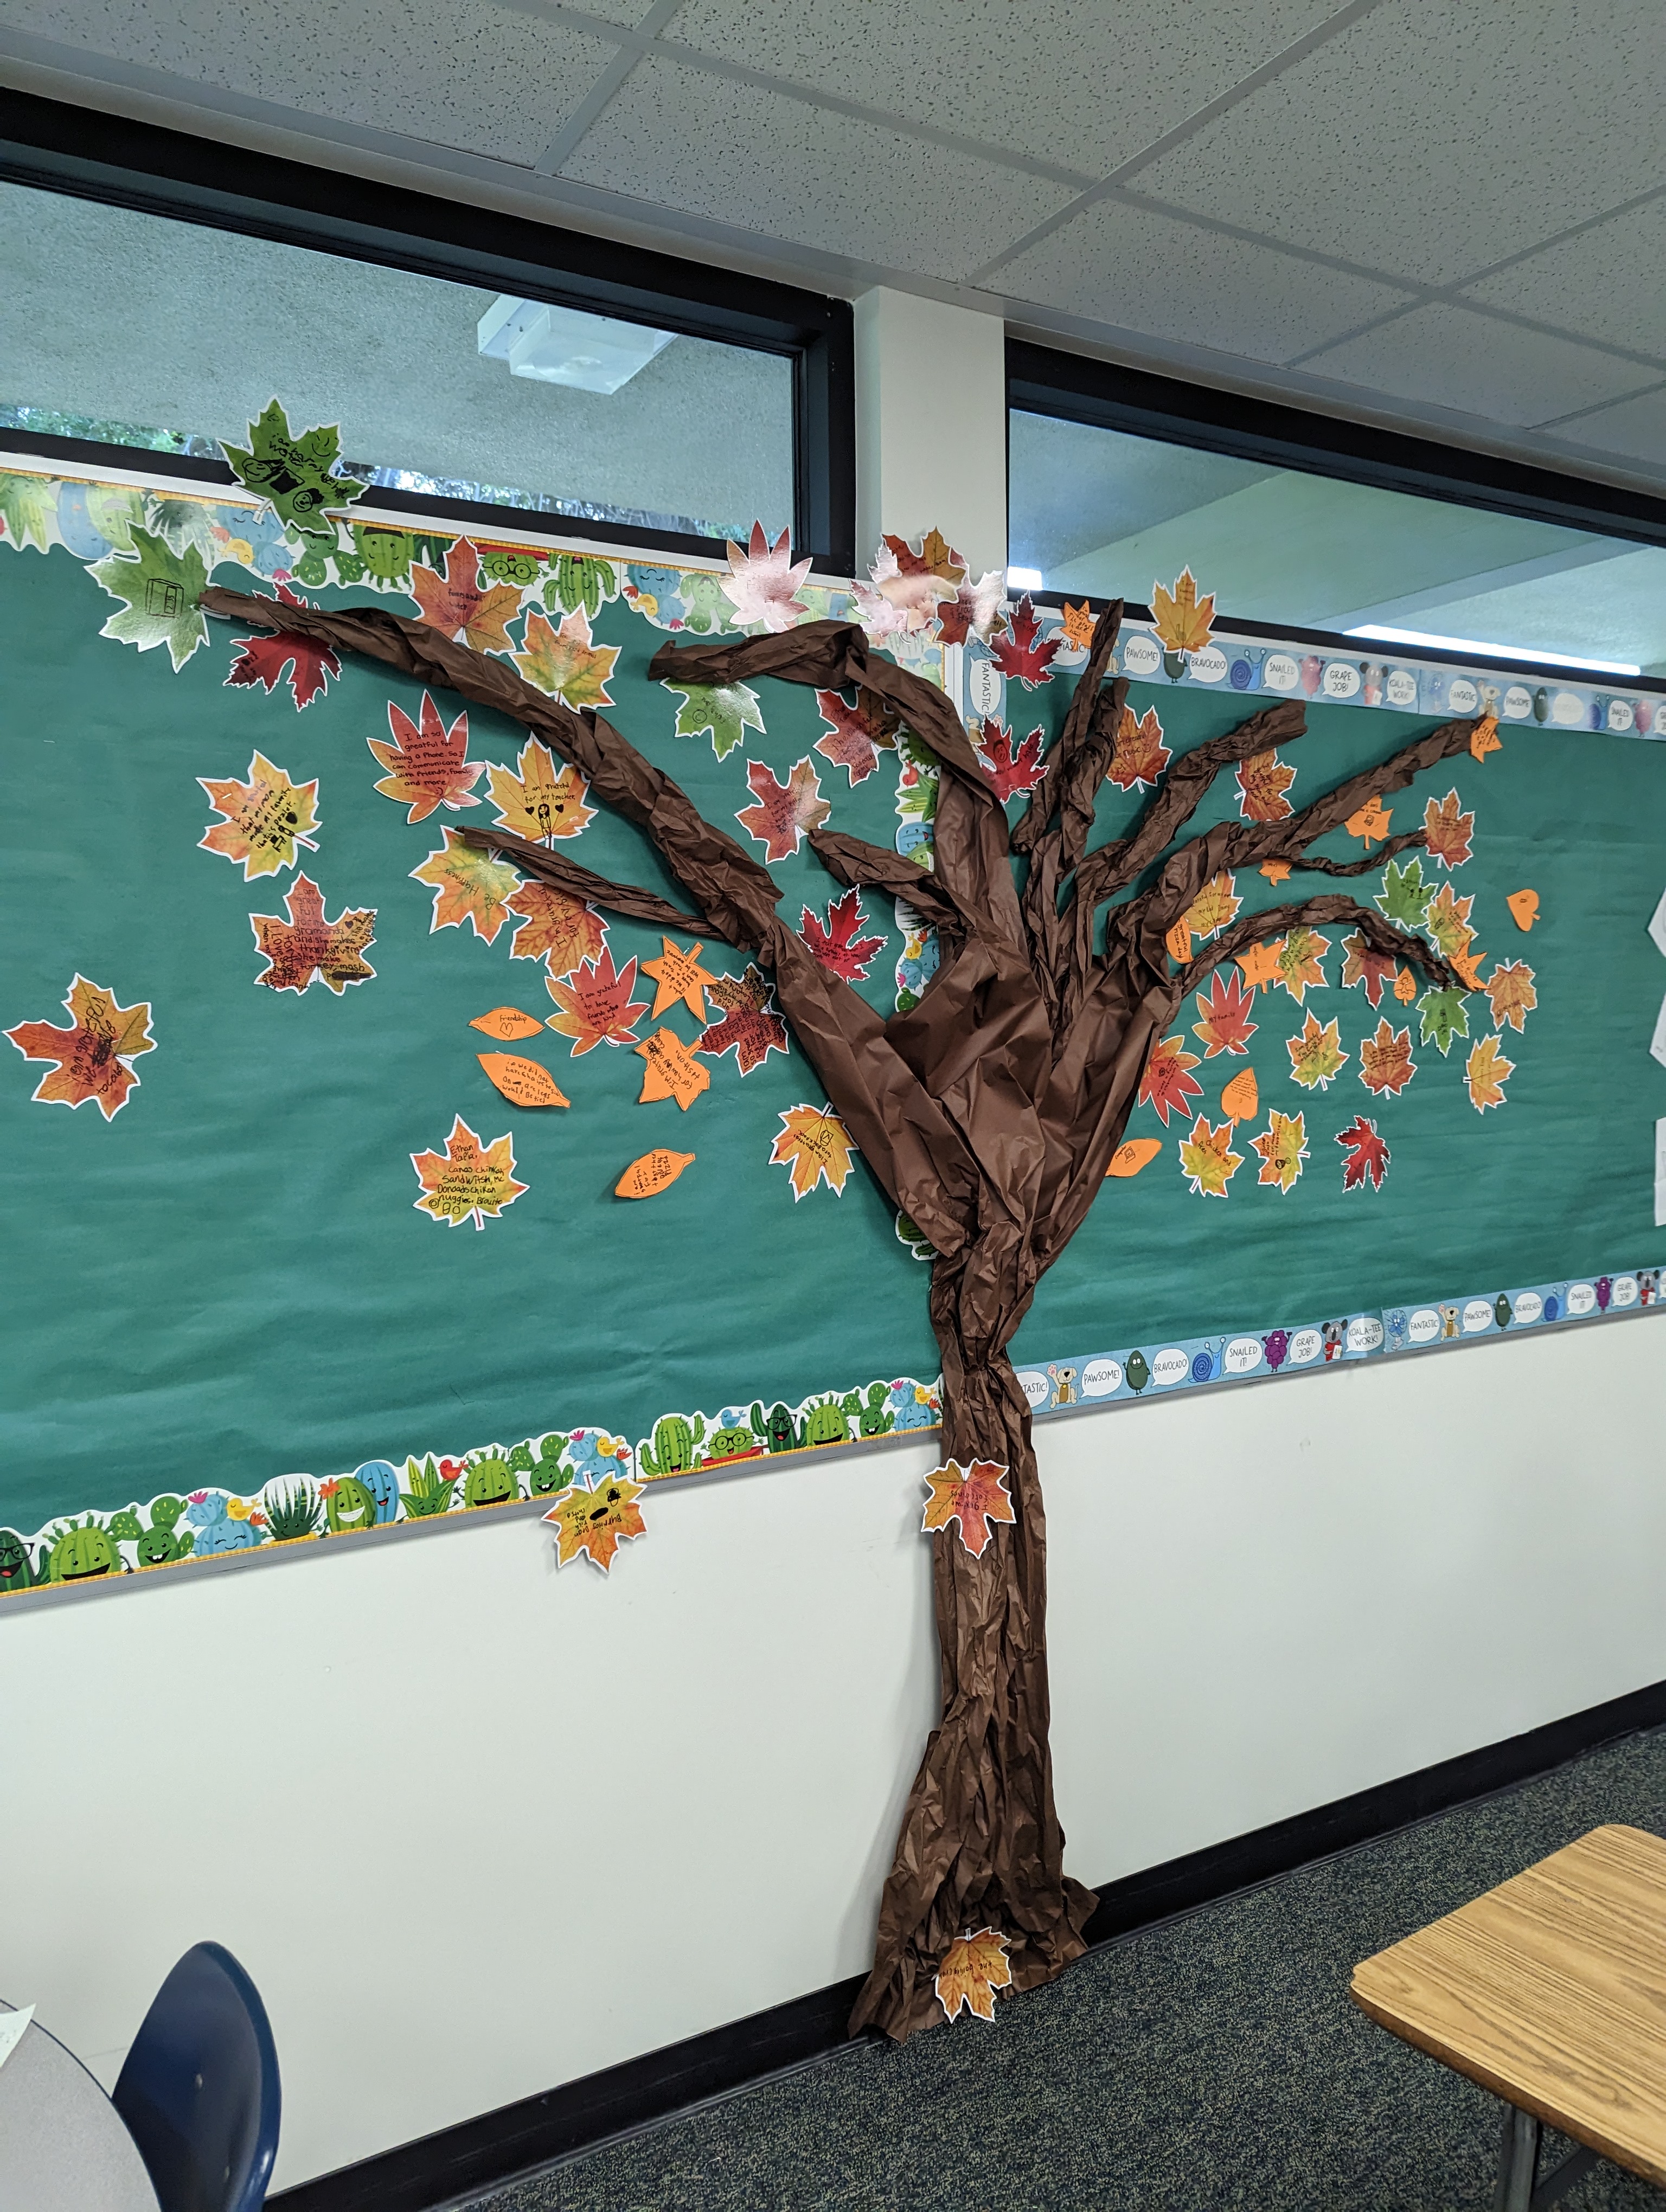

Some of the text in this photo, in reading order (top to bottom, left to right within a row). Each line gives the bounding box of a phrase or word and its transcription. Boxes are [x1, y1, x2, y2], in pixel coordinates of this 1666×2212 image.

[1126, 647, 1158, 661] PAWSOME!
[1330, 670, 1352, 681] GRAPE
[405, 741, 438, 751] greatful
[390, 755, 413, 763] having
[525, 795, 536, 803] for
[444, 869, 496, 910] Be Happiness
[566, 922, 579, 938] for
[578, 993, 584, 1001] I
[450, 1144, 473, 1155] Ethan
[1349, 1323, 1382, 1338] KOALA-TEE
[1296, 1336, 1315, 1347] GRAPE
[1354, 1335, 1379, 1346] WORK!
[1229, 1346, 1258, 1358] SNAILED
[1299, 1347, 1312, 1358] JOB!
[1154, 1358, 1188, 1373] BRAVOCADO!
[1084, 1369, 1119, 1385] PAWSOME!
[1023, 1381, 1048, 1394] TASTIC!
